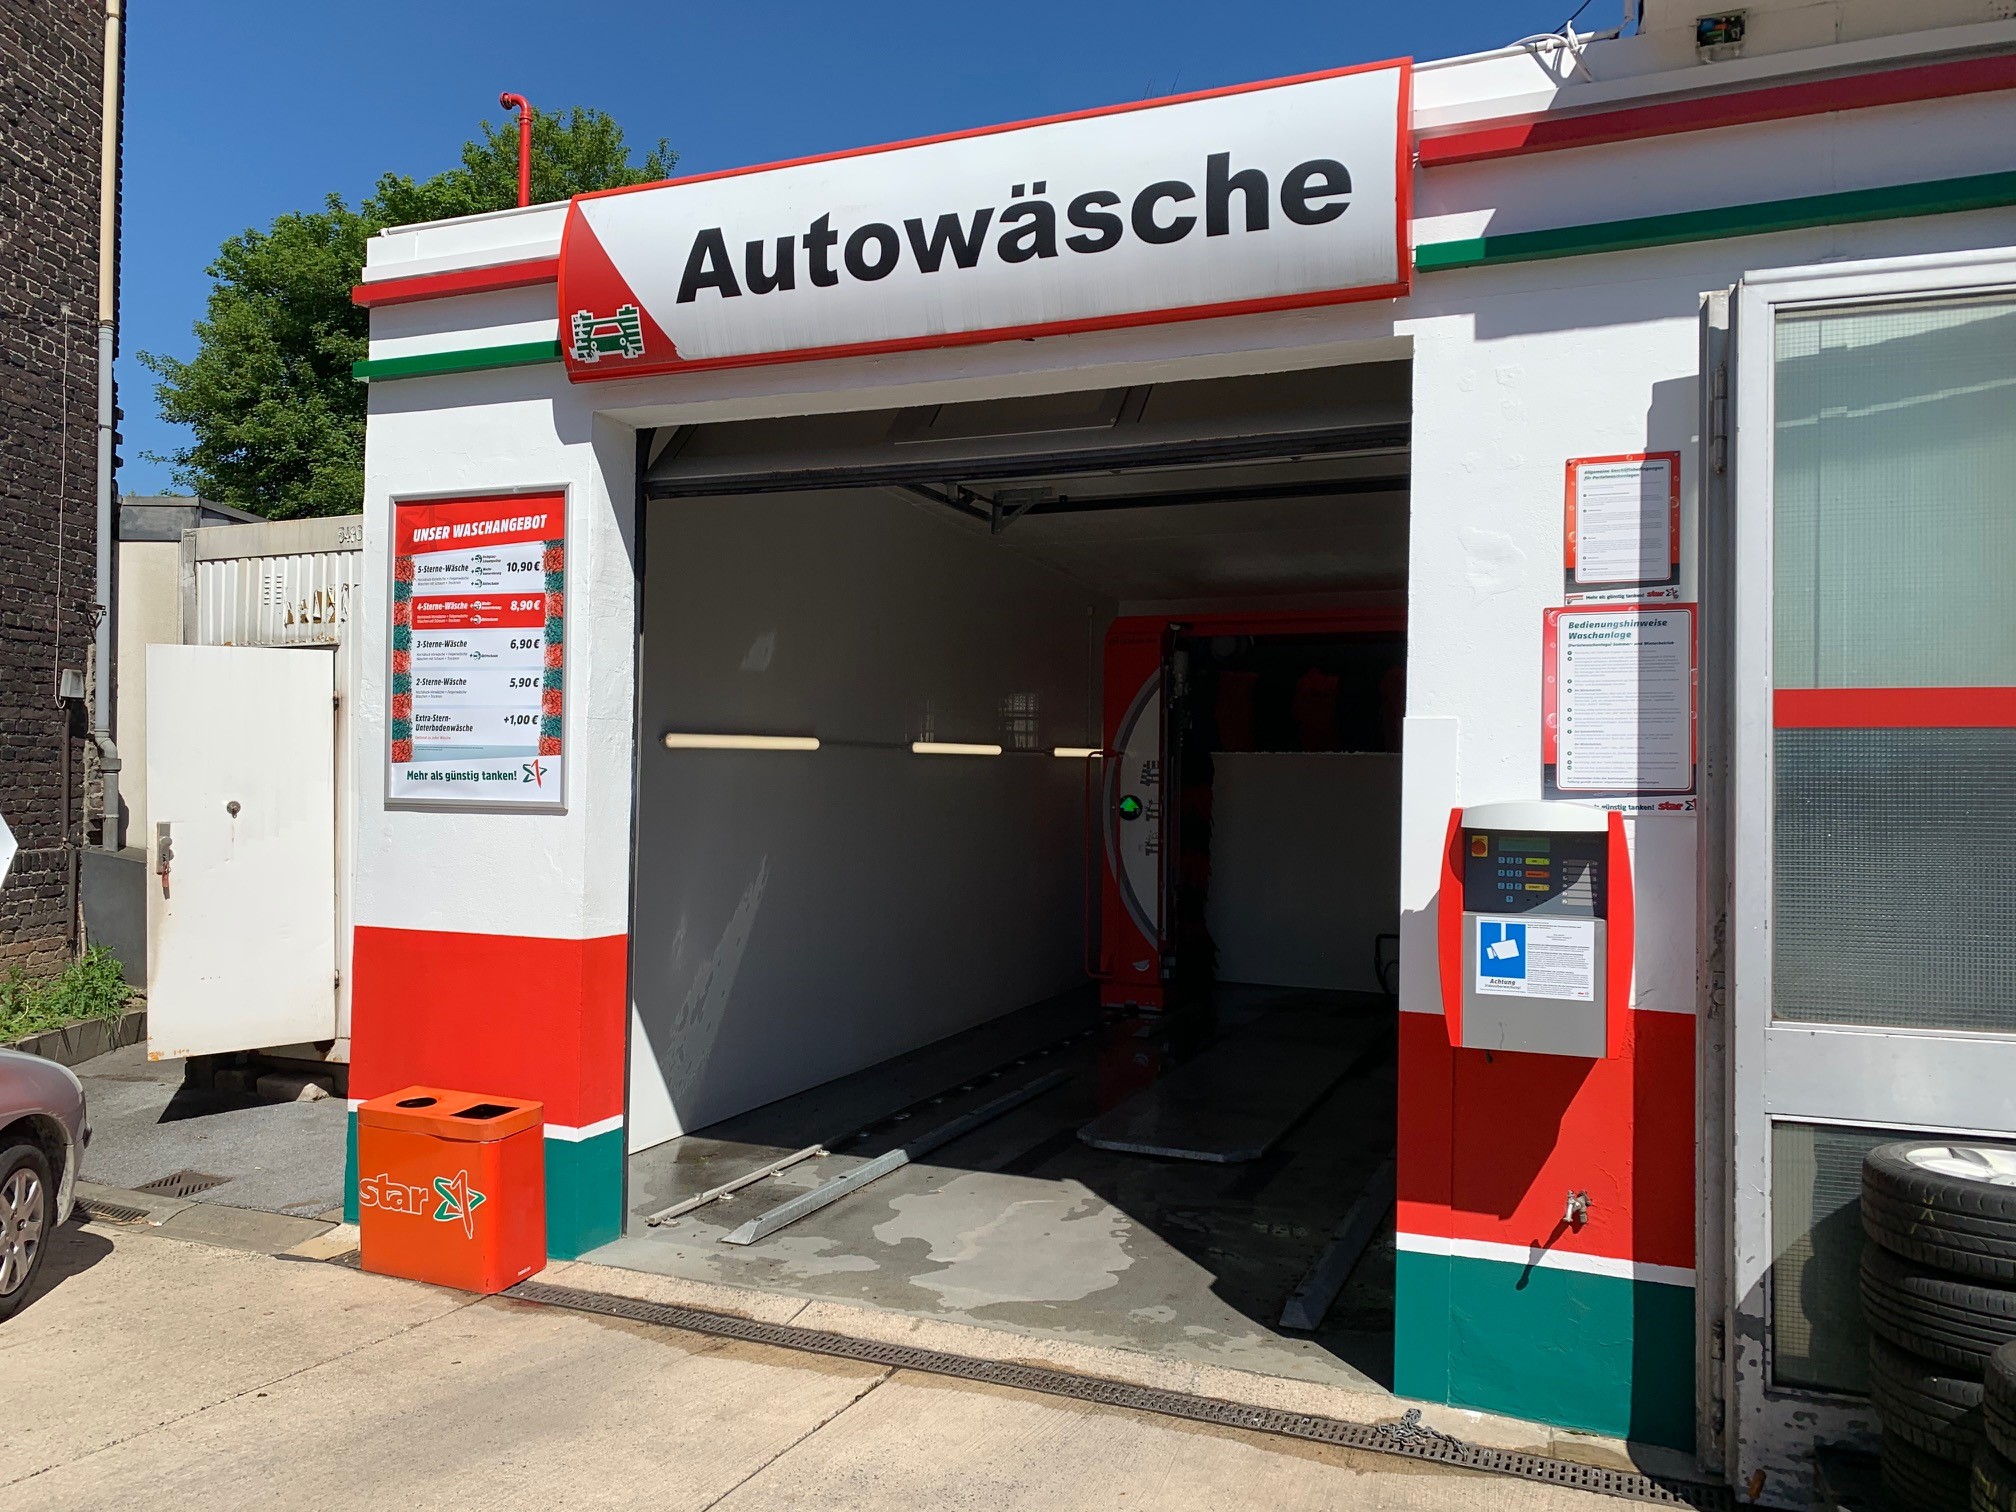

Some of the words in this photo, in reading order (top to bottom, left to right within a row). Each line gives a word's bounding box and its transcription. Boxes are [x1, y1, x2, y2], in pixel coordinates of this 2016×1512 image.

[675, 152, 1352, 303] Autowäsche
[413, 525, 450, 542] UNSER
[452, 514, 548, 538] WASCHANGEBOT
[417, 564, 469, 573] 5-Sterne-Wäsche
[506, 562, 531, 574] 10,90
[534, 561, 541, 572] €
[416, 601, 468, 611] 4-Sterne-Wäsche
[510, 600, 531, 612] 8,90
[533, 600, 541, 610] €
[1568, 619, 1668, 630] Bedienungshinweise
[1568, 631, 1632, 640] Waschanlage
[416, 640, 468, 649] 3-Sterne-Wäsche
[510, 639, 532, 650] 6,90
[533, 639, 540, 649] €
[415, 678, 467, 686] 2-Sterne-Wäsche
[509, 678, 532, 688] 5,90
[532, 678, 540, 687] €
[415, 714, 452, 722] Extra-Stern-
[503, 715, 530, 726] +1,00
[531, 715, 539, 725] €
[415, 724, 474, 732] Unterbodenwäsche
[406, 771, 428, 780] Mehr
[430, 770, 444, 780] als
[445, 770, 480, 782] günstig
[481, 770, 517, 780] tanken!
[1658, 801, 1684, 811] star
[359, 1173, 429, 1215] star
